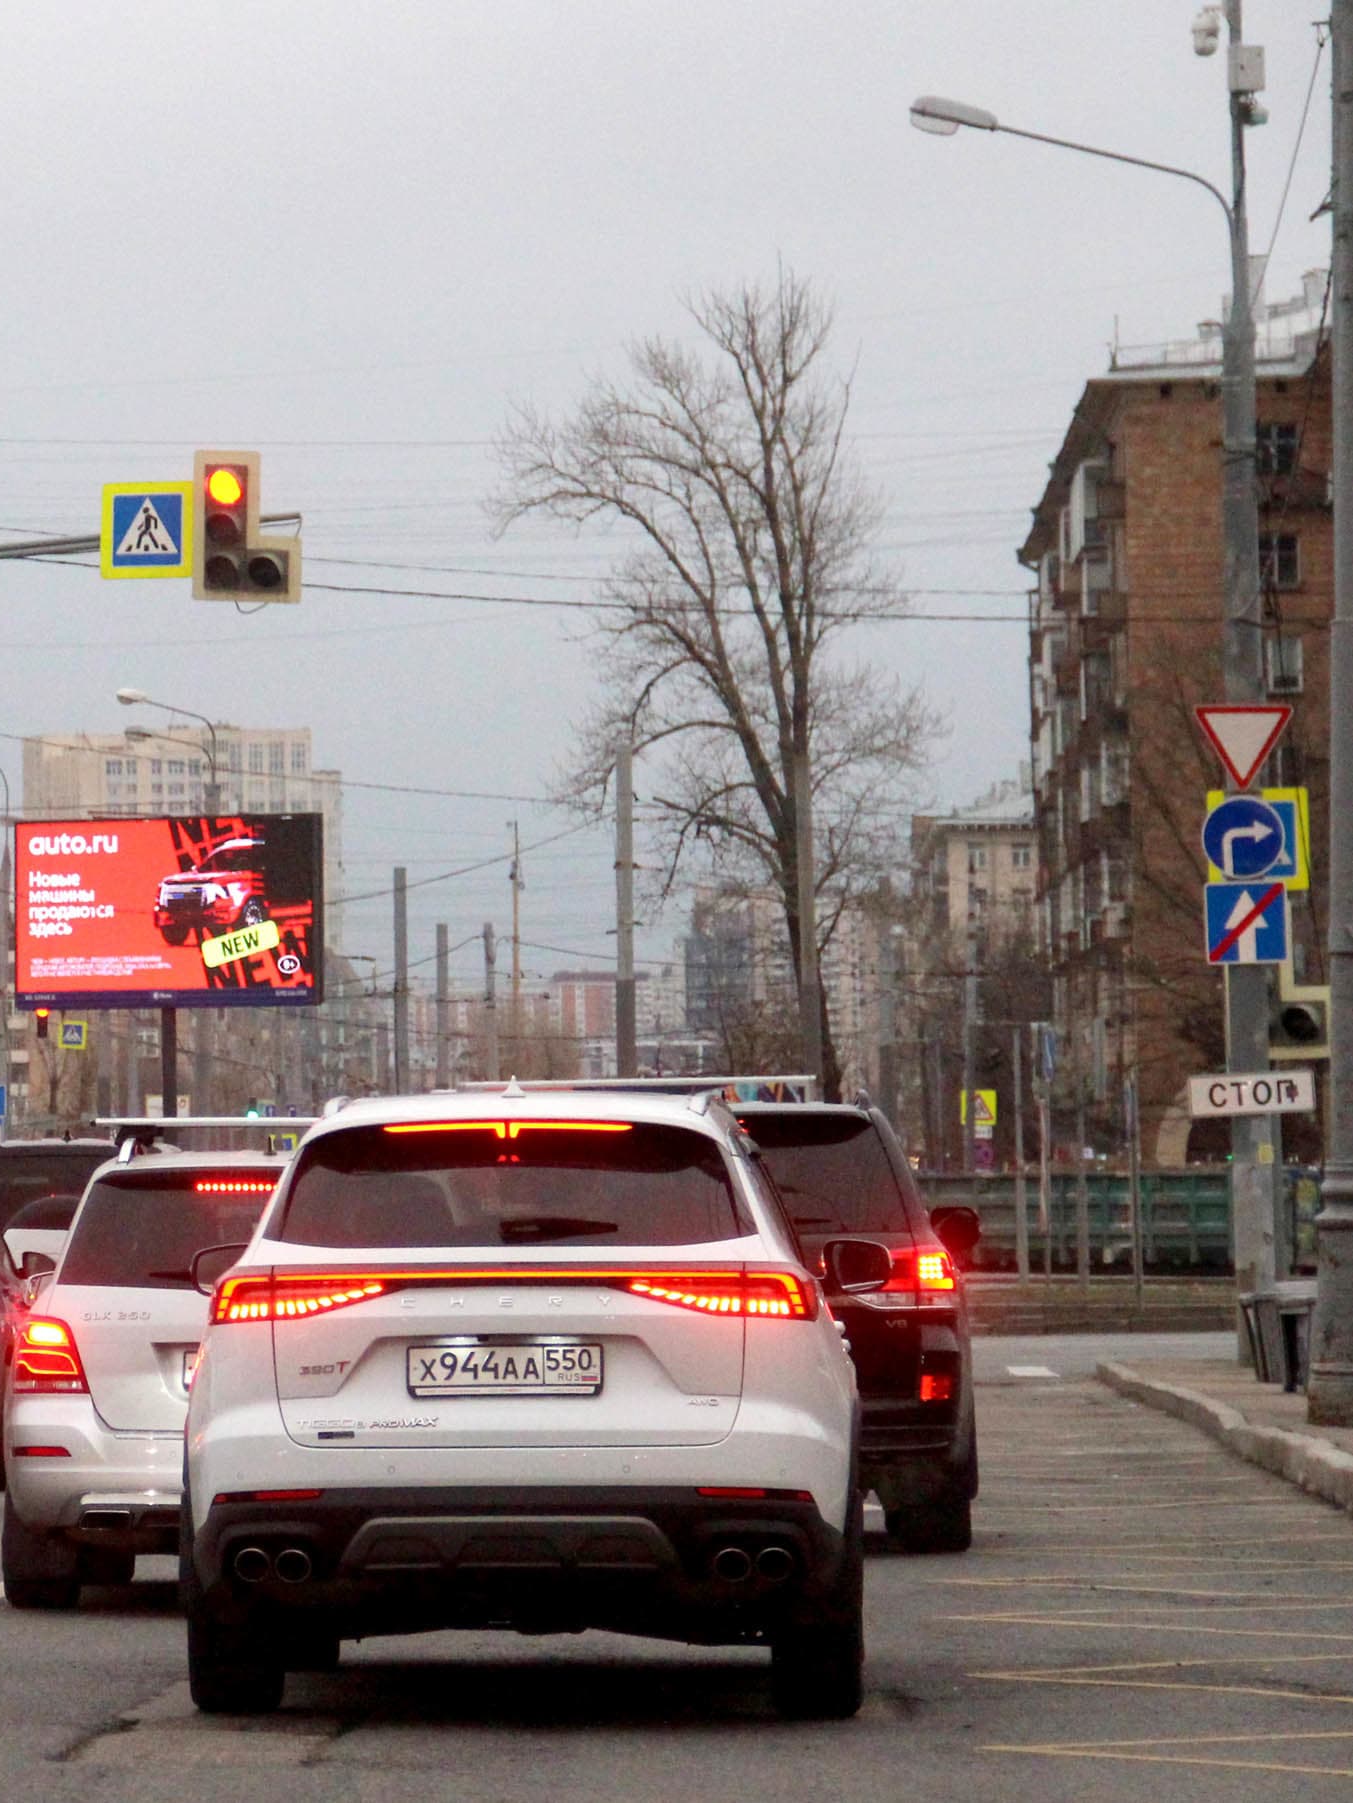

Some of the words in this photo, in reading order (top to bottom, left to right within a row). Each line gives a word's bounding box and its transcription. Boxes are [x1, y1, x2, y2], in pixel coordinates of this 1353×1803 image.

[29, 833, 118, 855] auto.ru
[29, 871, 80, 888] Новые
[29, 889, 95, 904] машины
[29, 904, 115, 922] продаются
[29, 922, 73, 938] здесь
[221, 931, 259, 956] NEW
[1209, 1080, 1298, 1107] СТОП
[401, 1296, 611, 1309] CHERY
[546, 1349, 592, 1371] 550
[558, 1373, 580, 1382] RUS
